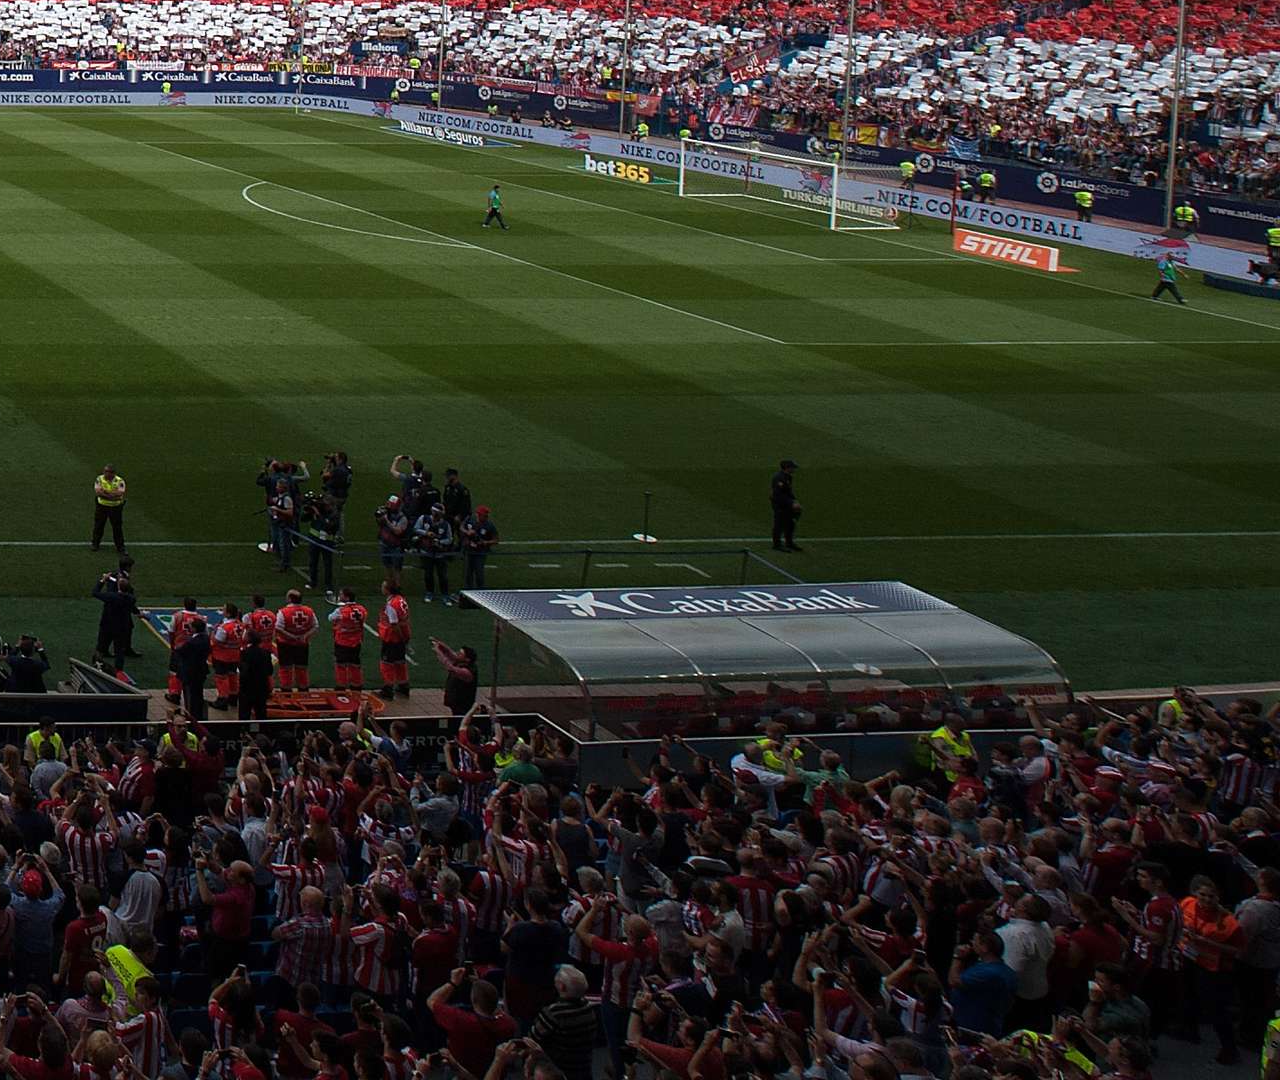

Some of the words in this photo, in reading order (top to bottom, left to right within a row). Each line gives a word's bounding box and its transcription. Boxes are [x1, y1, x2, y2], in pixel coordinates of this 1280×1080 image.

[361, 42, 399, 52] Mahou
[82, 71, 125, 81] CaixaBank
[155, 71, 198, 81] CaixaBank
[229, 73, 274, 82] CaixaBank
[307, 74, 355, 86] CaixaBank
[1, 94, 131, 104] NIKE.COM/FOOTBALL
[214, 95, 349, 109] NIKE.COM/FOOTBALL
[400, 120, 433, 136] Allianz
[444, 127, 484, 146] Seguros
[418, 111, 534, 139] NIKE.COM/FOOTBALL
[584, 154, 651, 184] bet365
[621, 143, 764, 180] NIKE.COM/FOOTBALL
[876, 190, 1084, 241] NIKE.COM/FOOTBALL
[960, 235, 1040, 265] STIHL
[620, 590, 880, 617] CaixaBank
